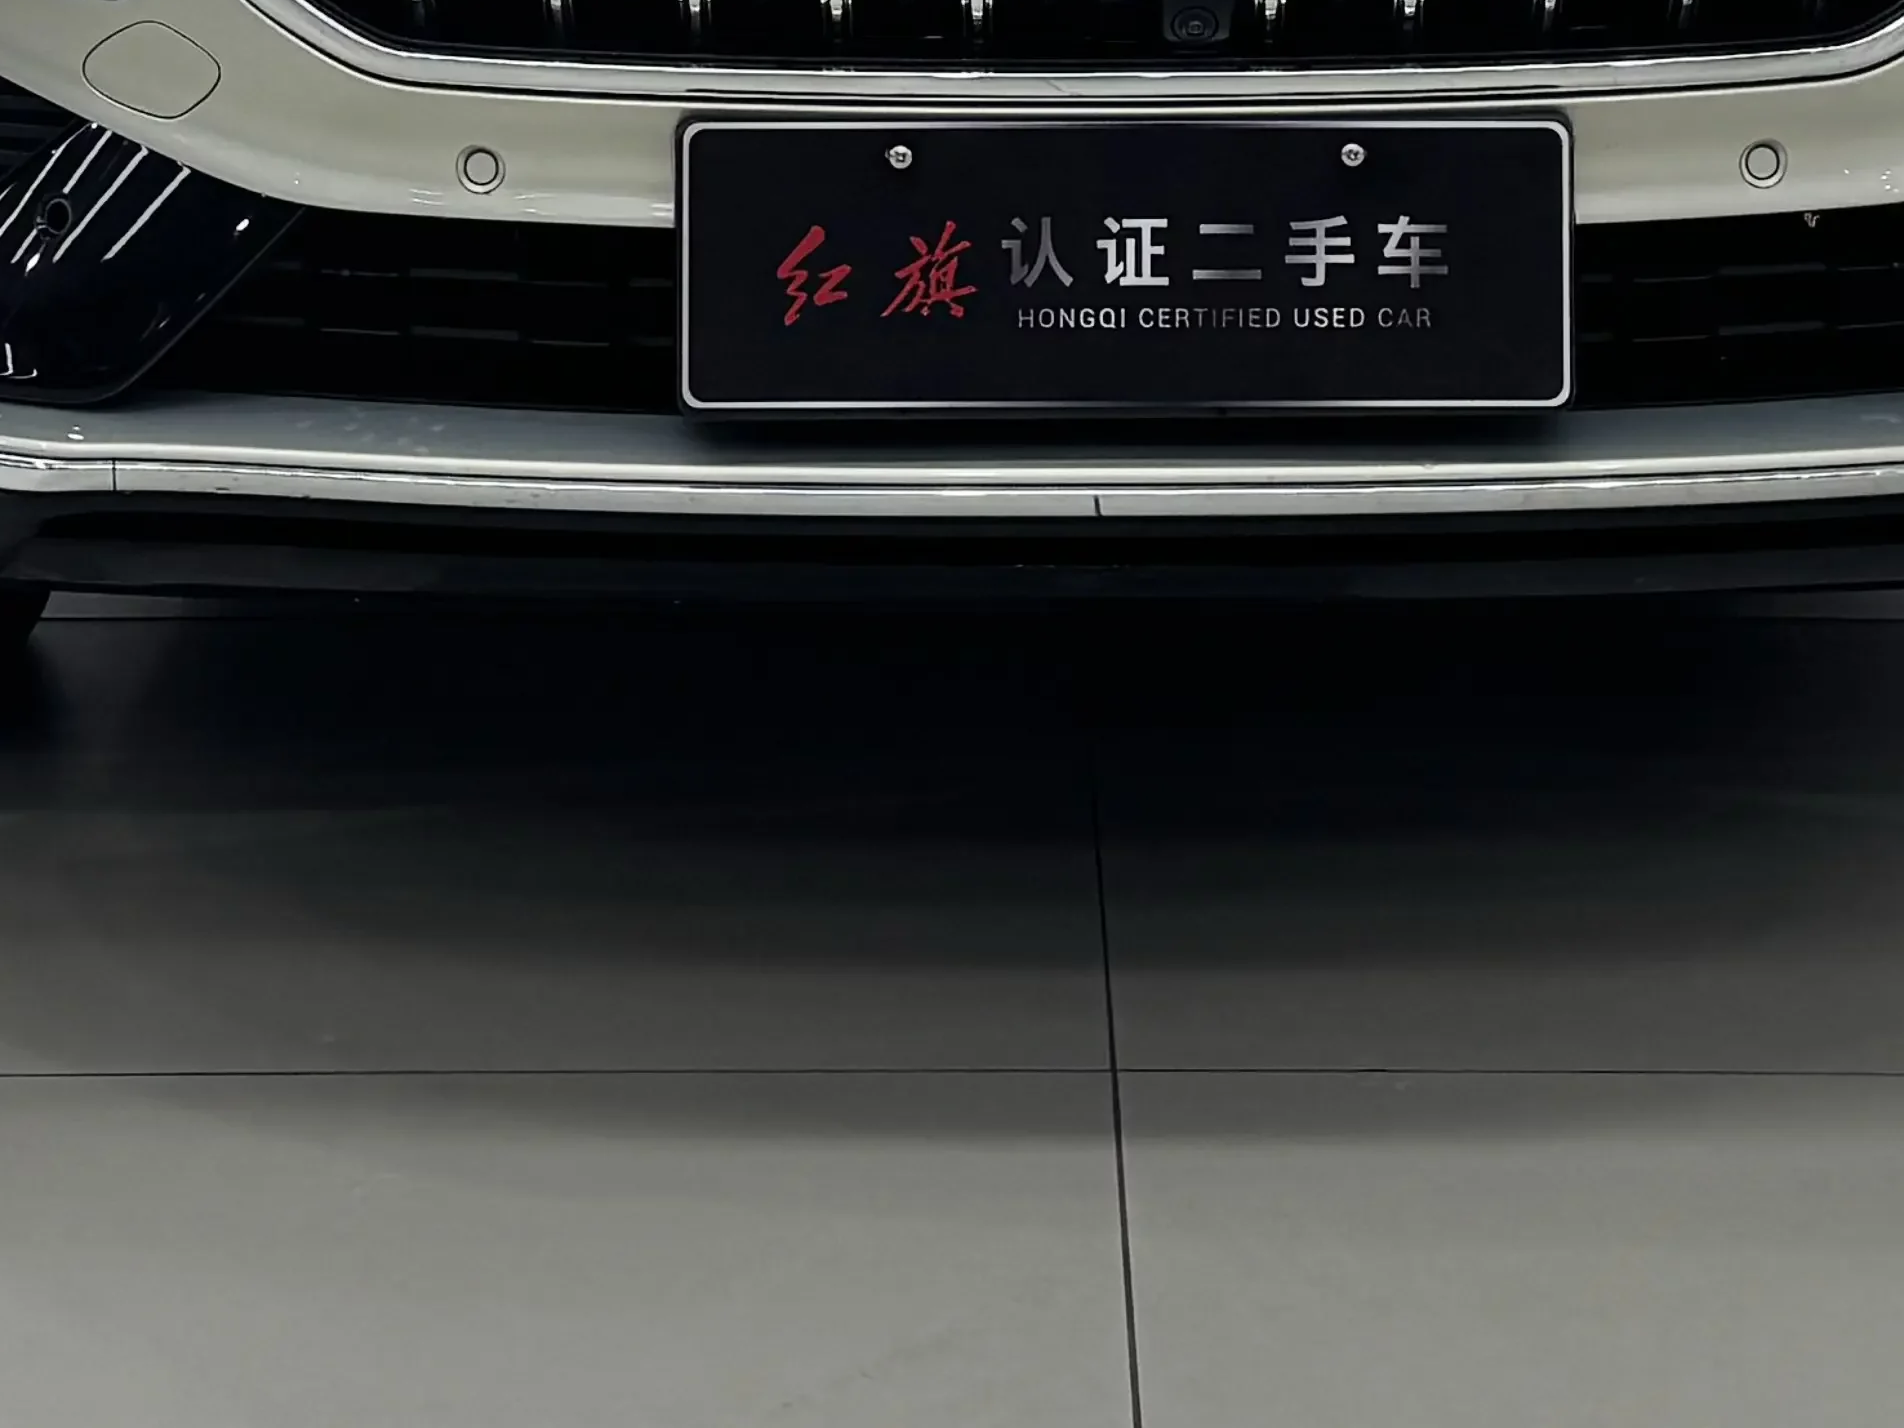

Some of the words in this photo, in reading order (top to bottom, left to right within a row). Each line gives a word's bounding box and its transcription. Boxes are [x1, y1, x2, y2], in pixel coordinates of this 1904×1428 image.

[776, 220, 979, 327] 红旗
[1001, 216, 1449, 290] 认证二手车
[1018, 307, 1126, 330] HONGQI
[1139, 307, 1281, 330] CERTIFIED
[1294, 307, 1365, 329] USED
[1378, 307, 1432, 328] CAR
